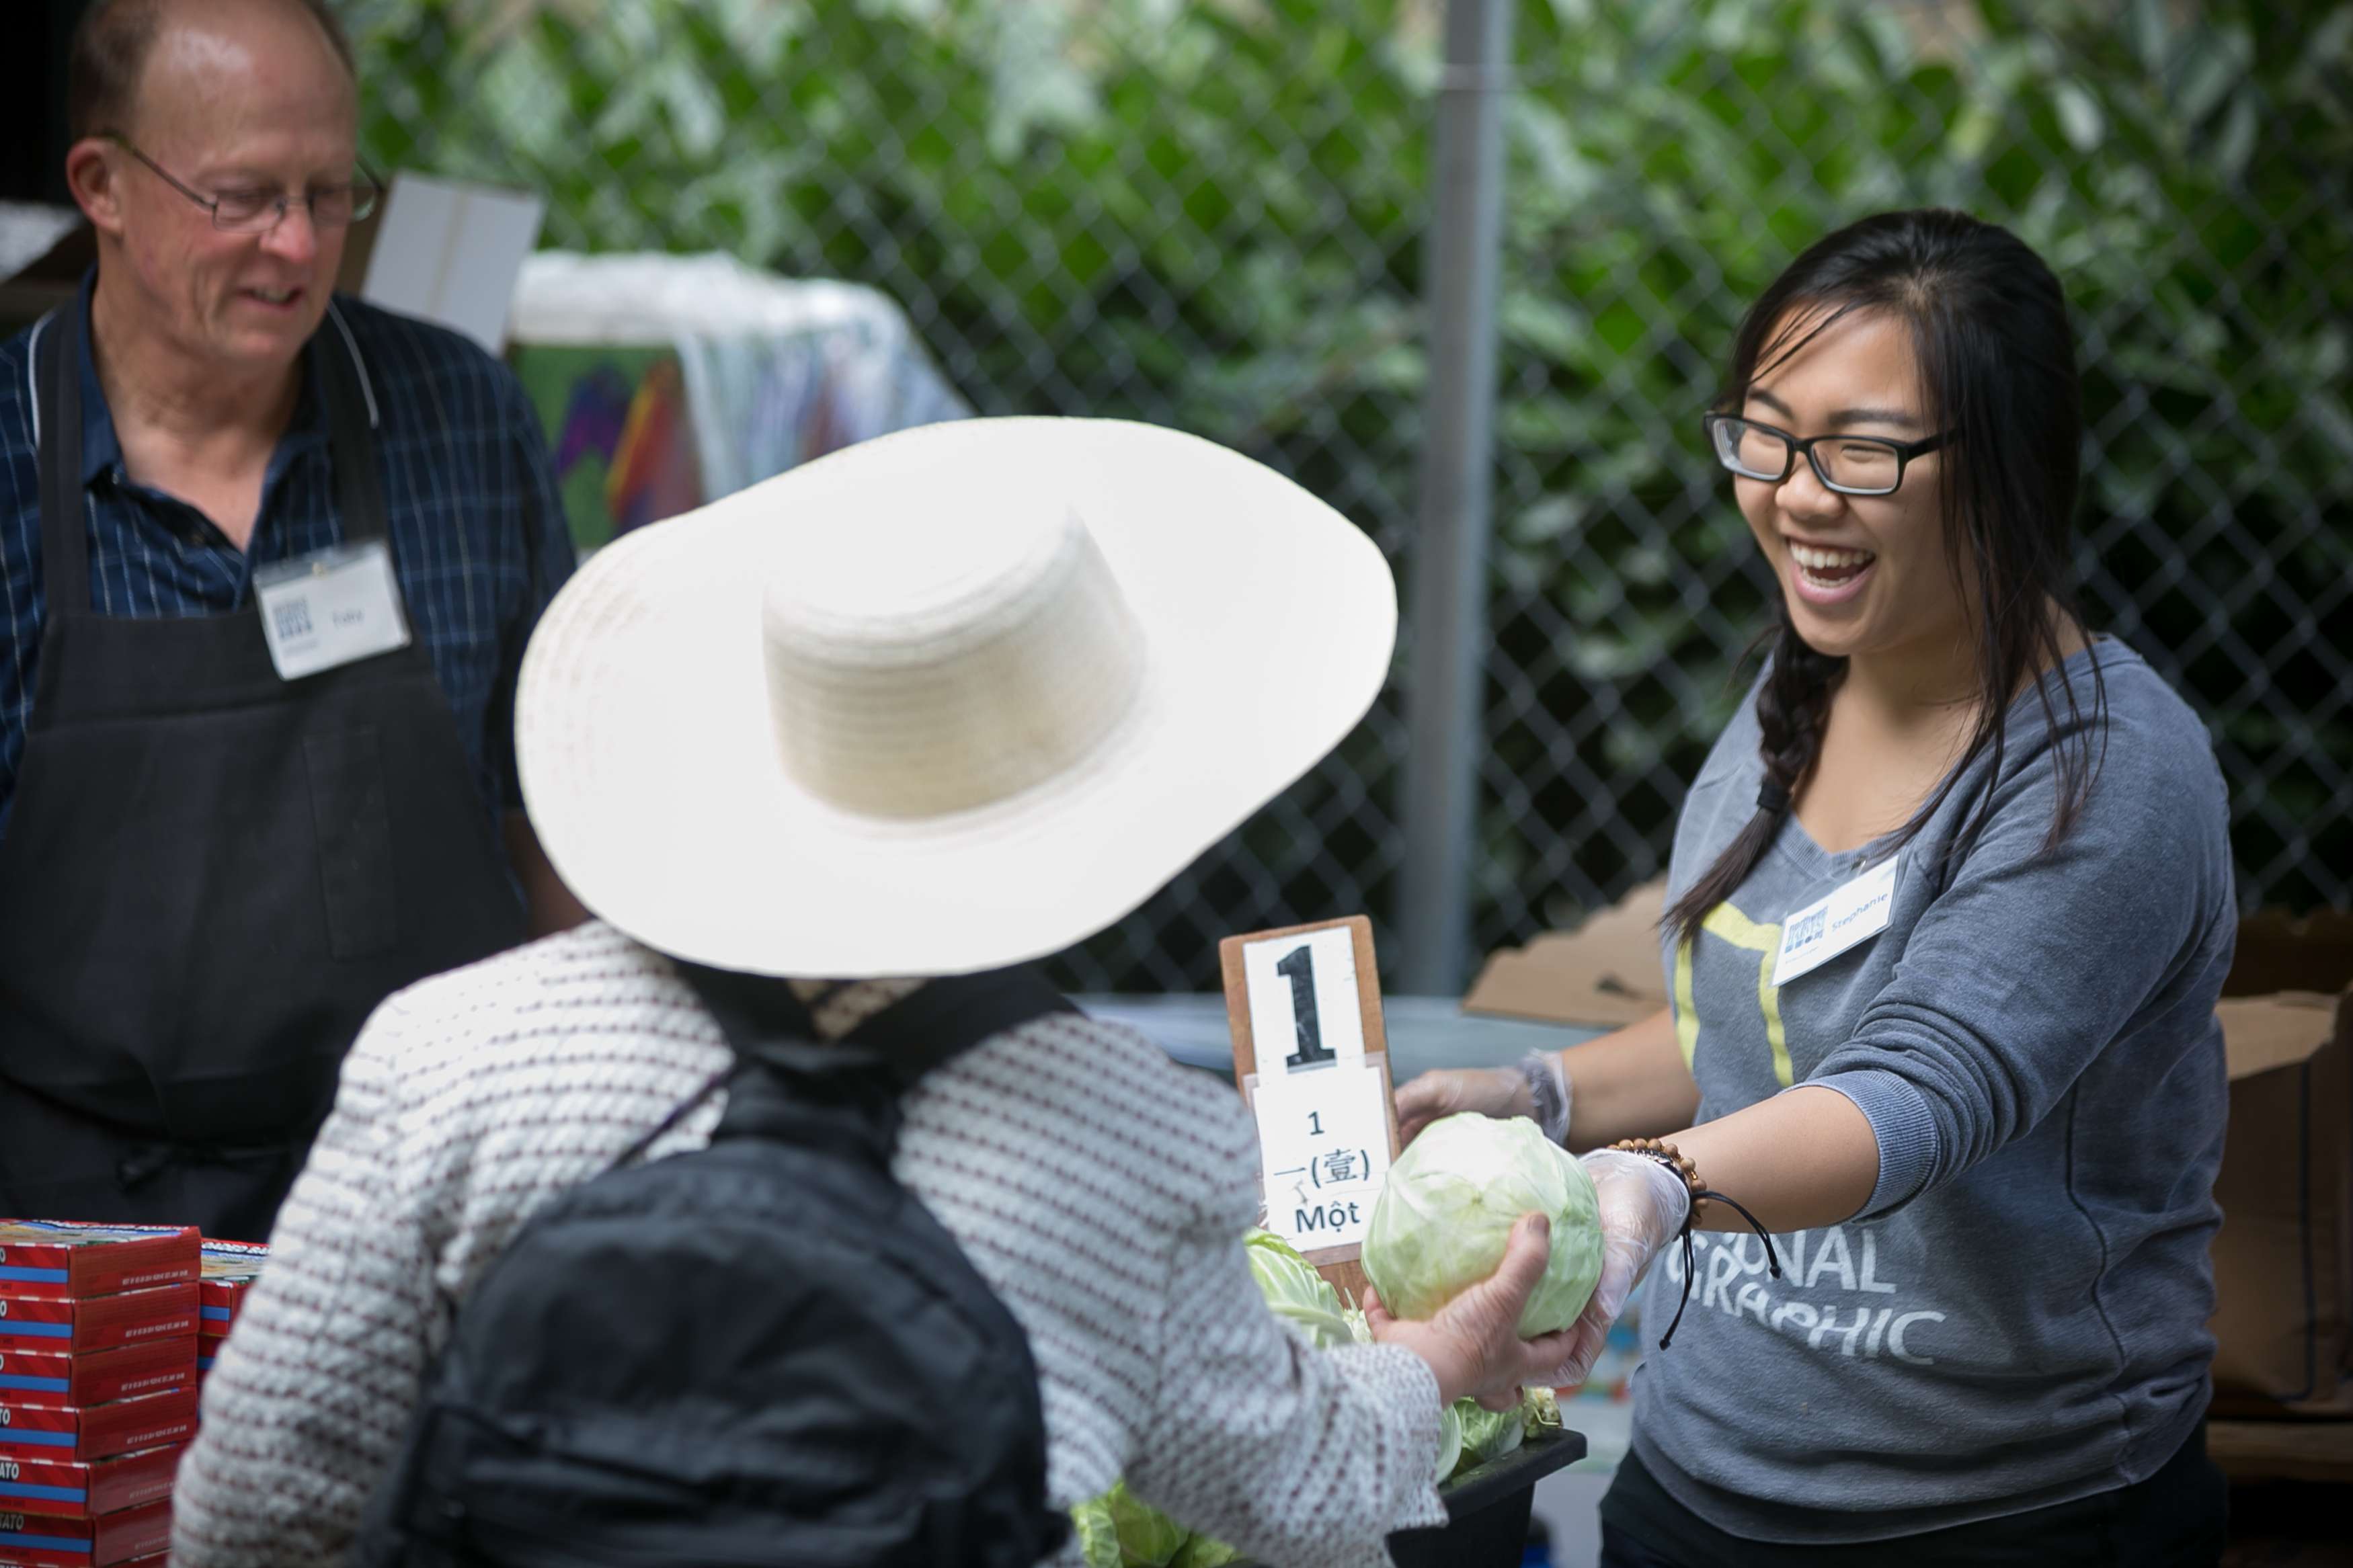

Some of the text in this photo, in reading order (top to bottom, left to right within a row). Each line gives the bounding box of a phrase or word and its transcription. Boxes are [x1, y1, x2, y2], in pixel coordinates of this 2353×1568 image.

[1831, 893, 1888, 932] Stephanie
[1277, 944, 1337, 1073] 1
[1307, 1110, 1325, 1136] 1
[1295, 1200, 1361, 1233] Một
